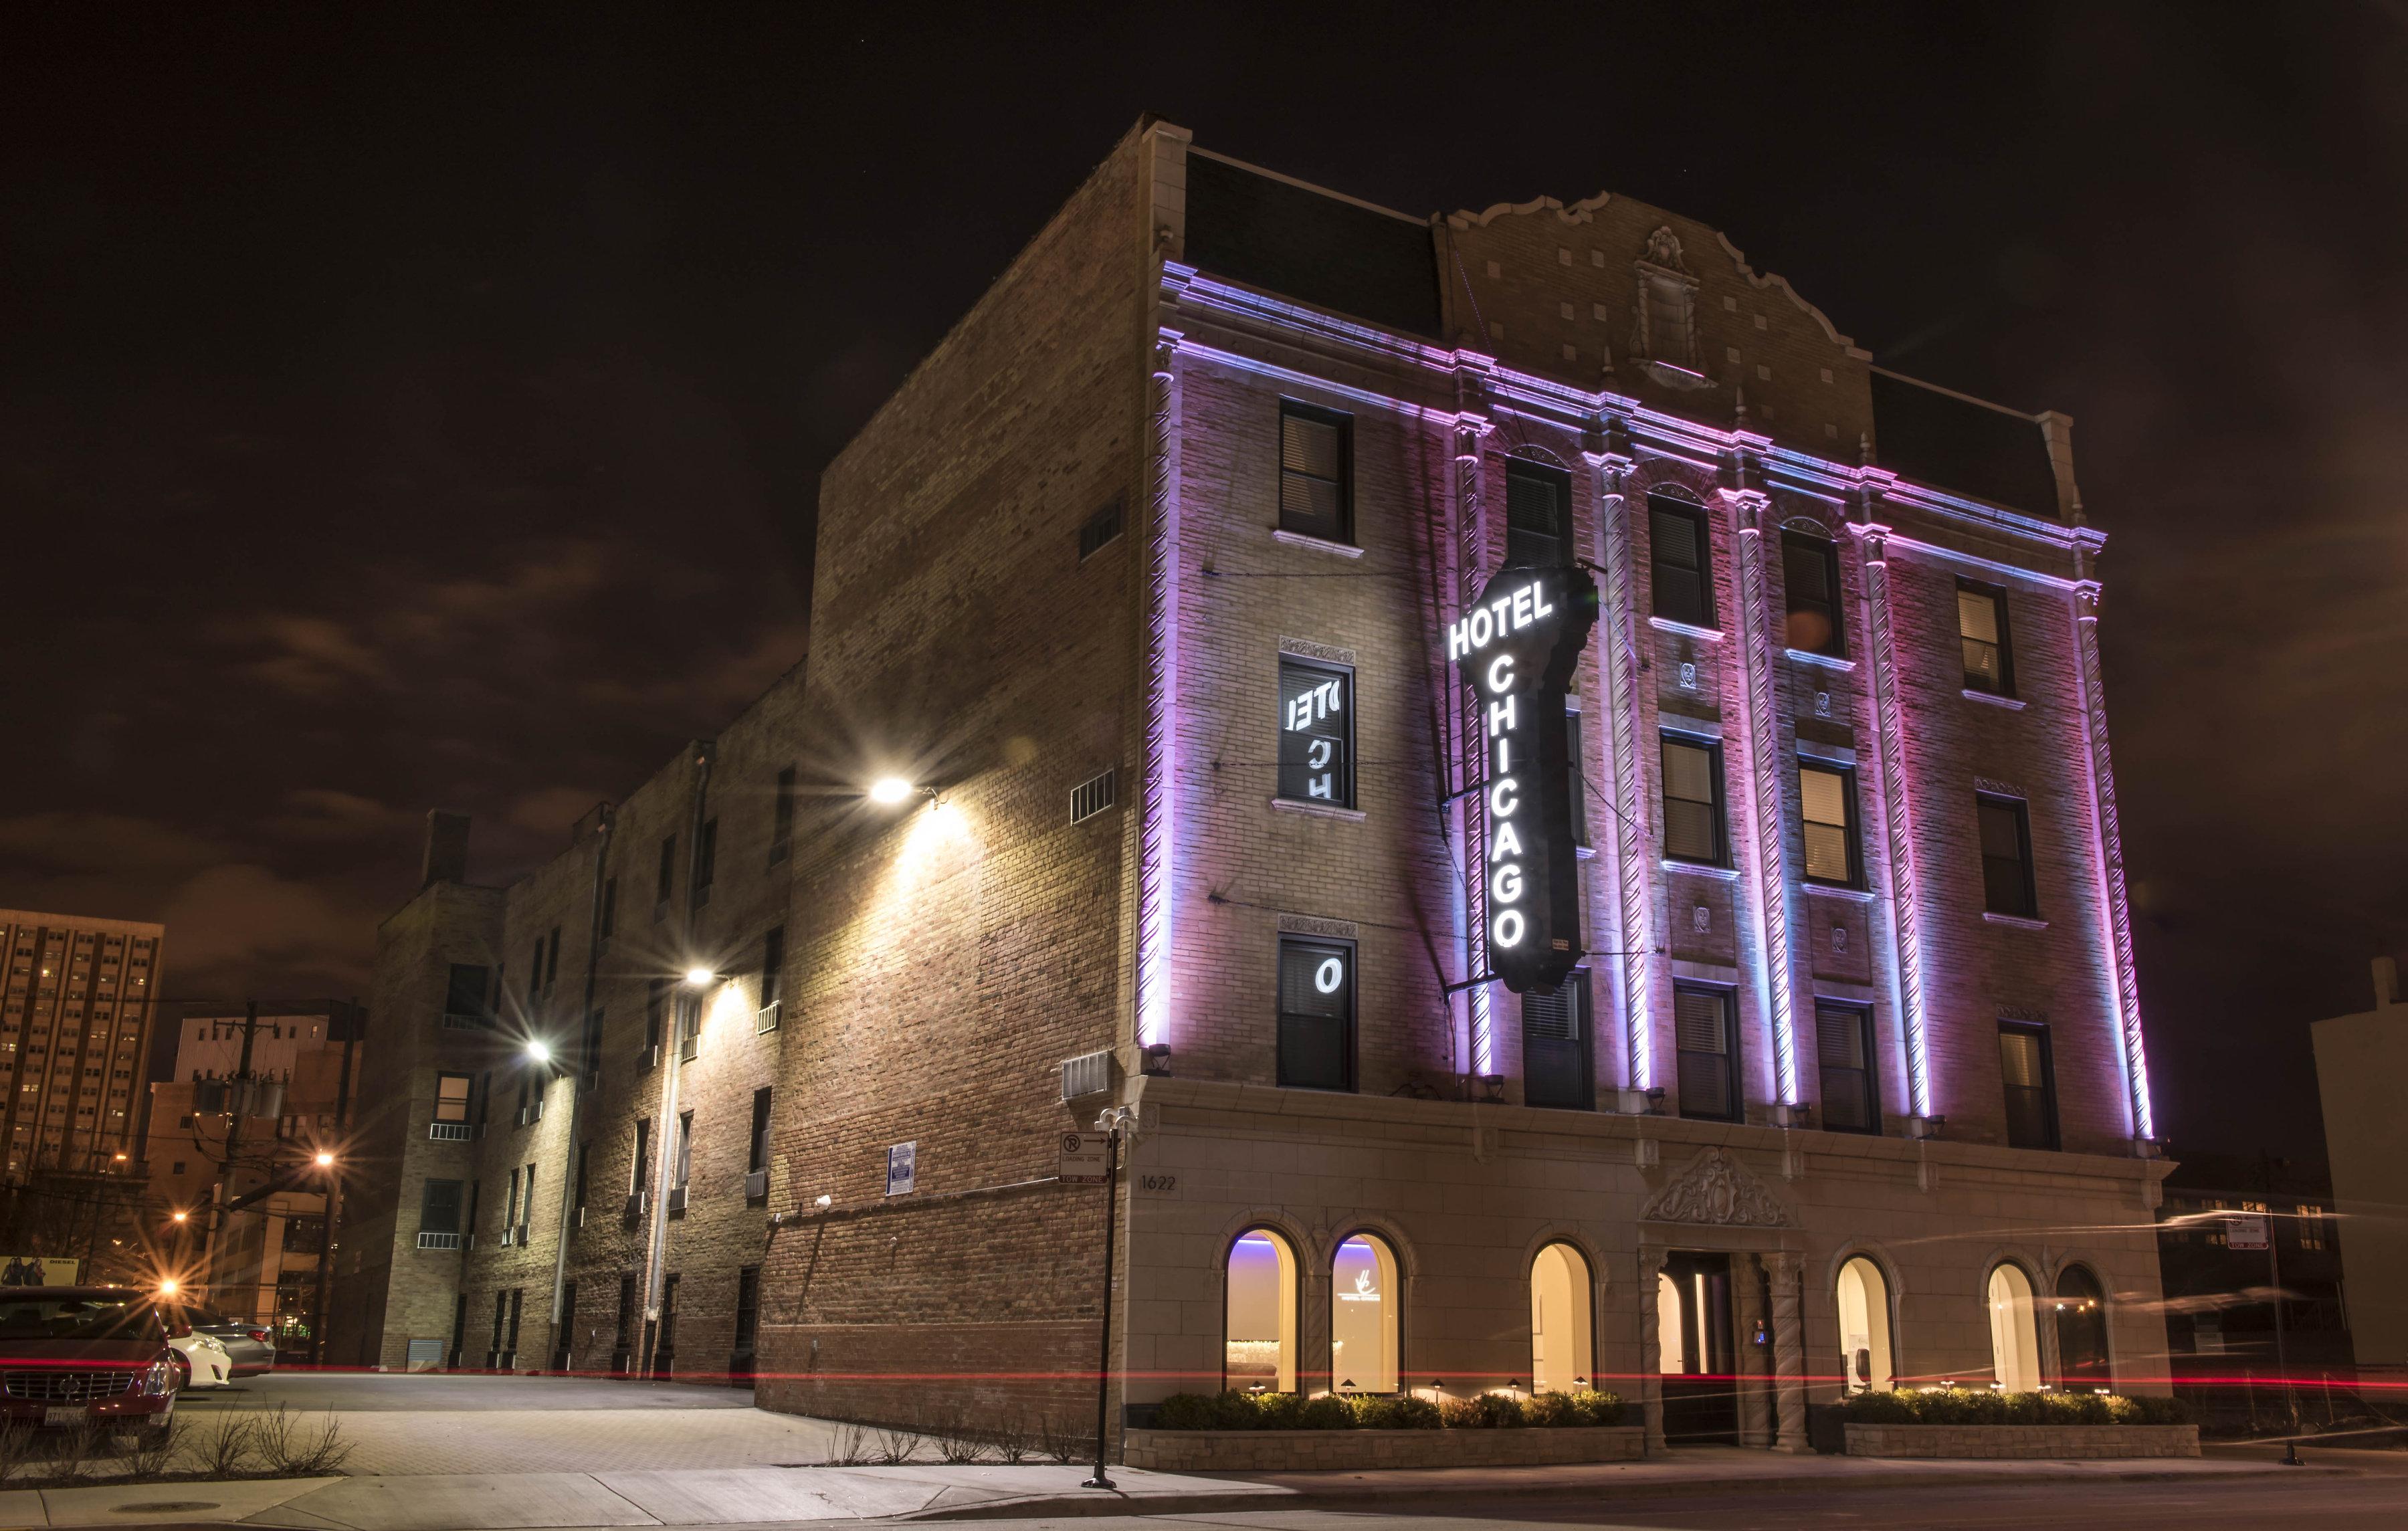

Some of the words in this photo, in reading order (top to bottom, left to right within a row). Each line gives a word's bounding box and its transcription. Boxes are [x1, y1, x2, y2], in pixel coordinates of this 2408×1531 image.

[1449, 581, 1552, 661] HOTEL
[1488, 655, 1524, 948] CHICAGO
[1142, 1175, 1175, 1191] 1622
